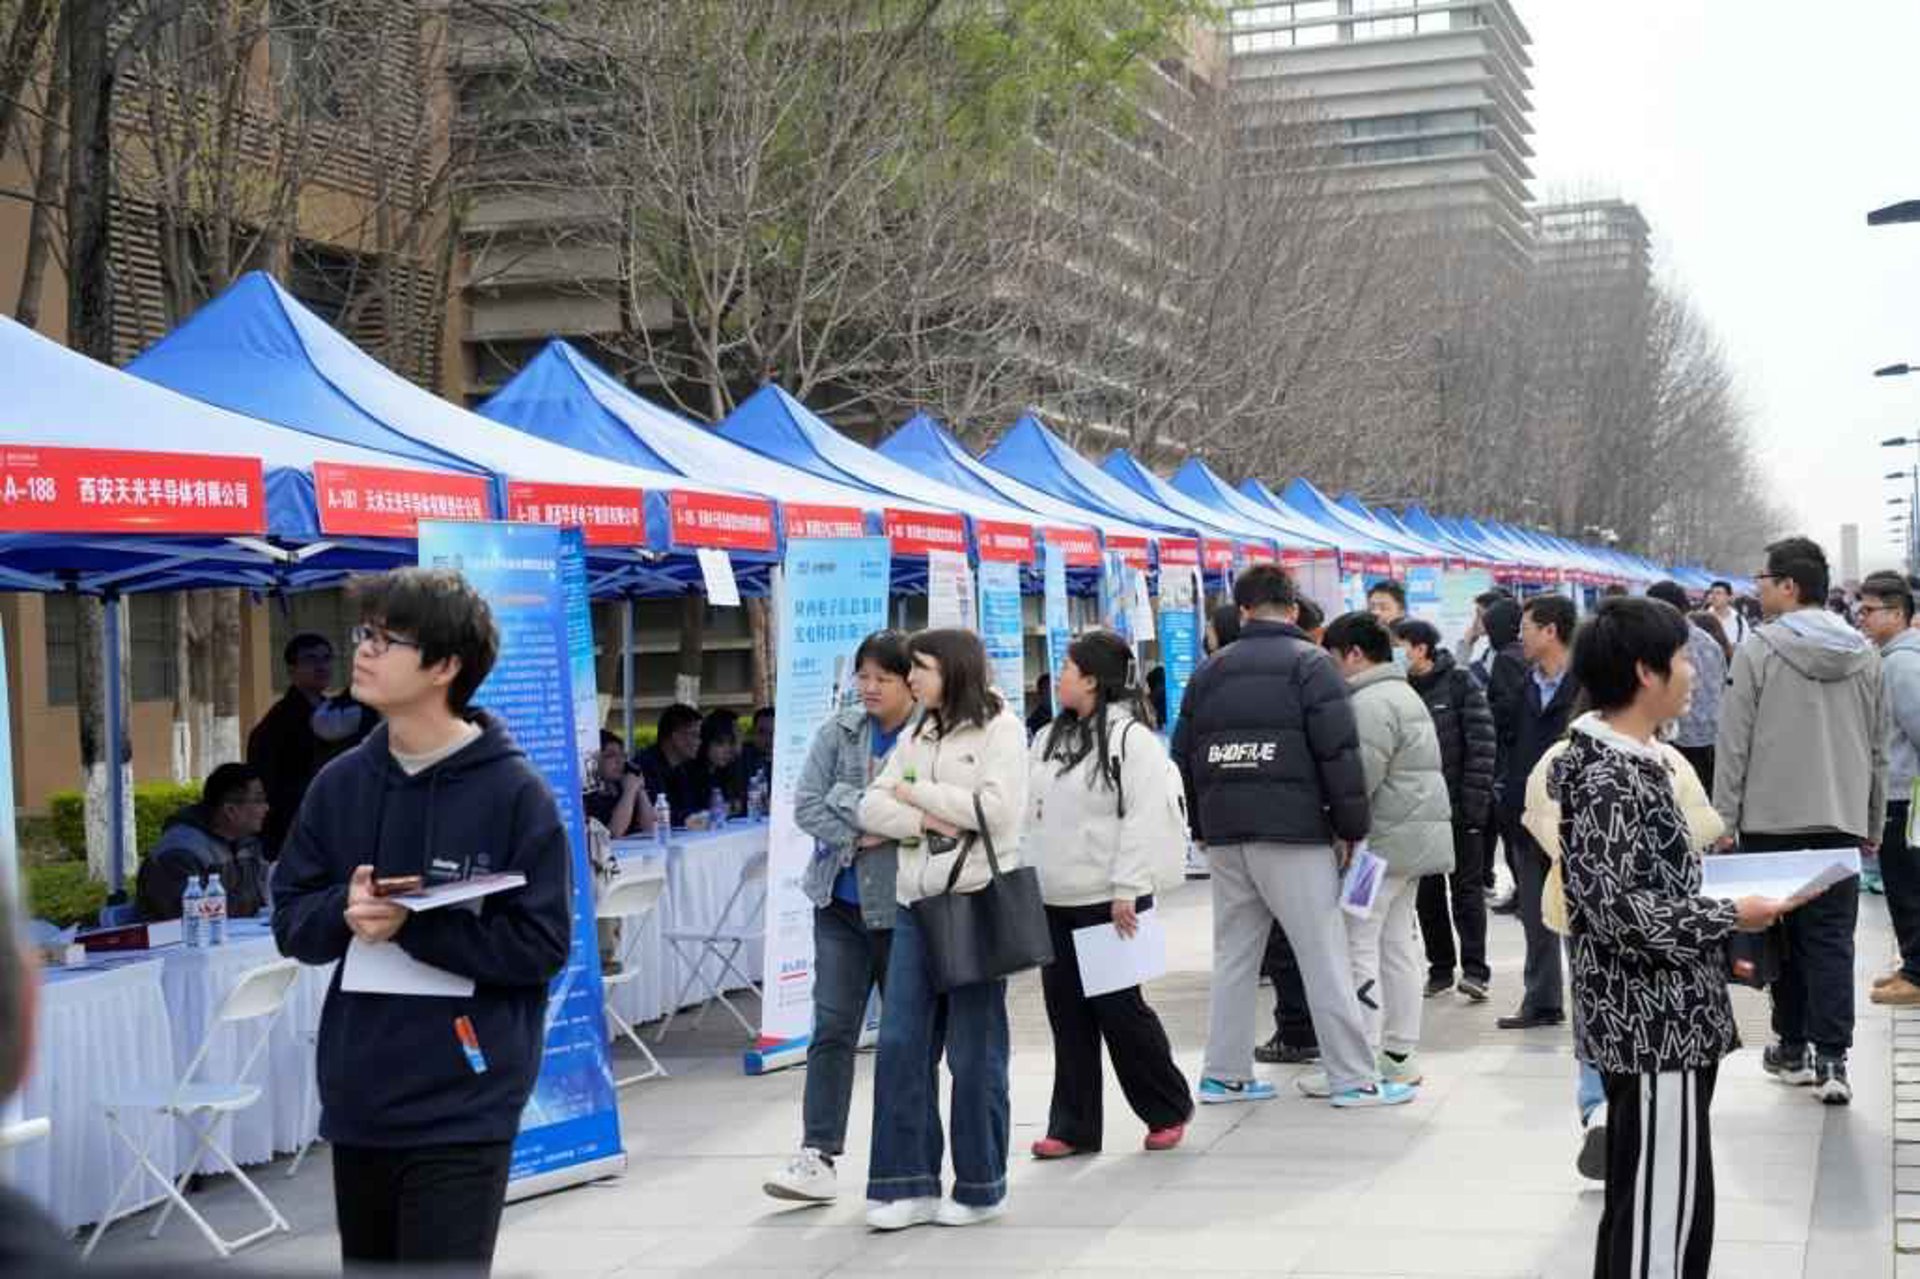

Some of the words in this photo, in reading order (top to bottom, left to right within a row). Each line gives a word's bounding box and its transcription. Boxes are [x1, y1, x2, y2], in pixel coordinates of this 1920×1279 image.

[4, 474, 57, 504] A-188
[79, 476, 248, 508] 西安天光半导体有限公司
